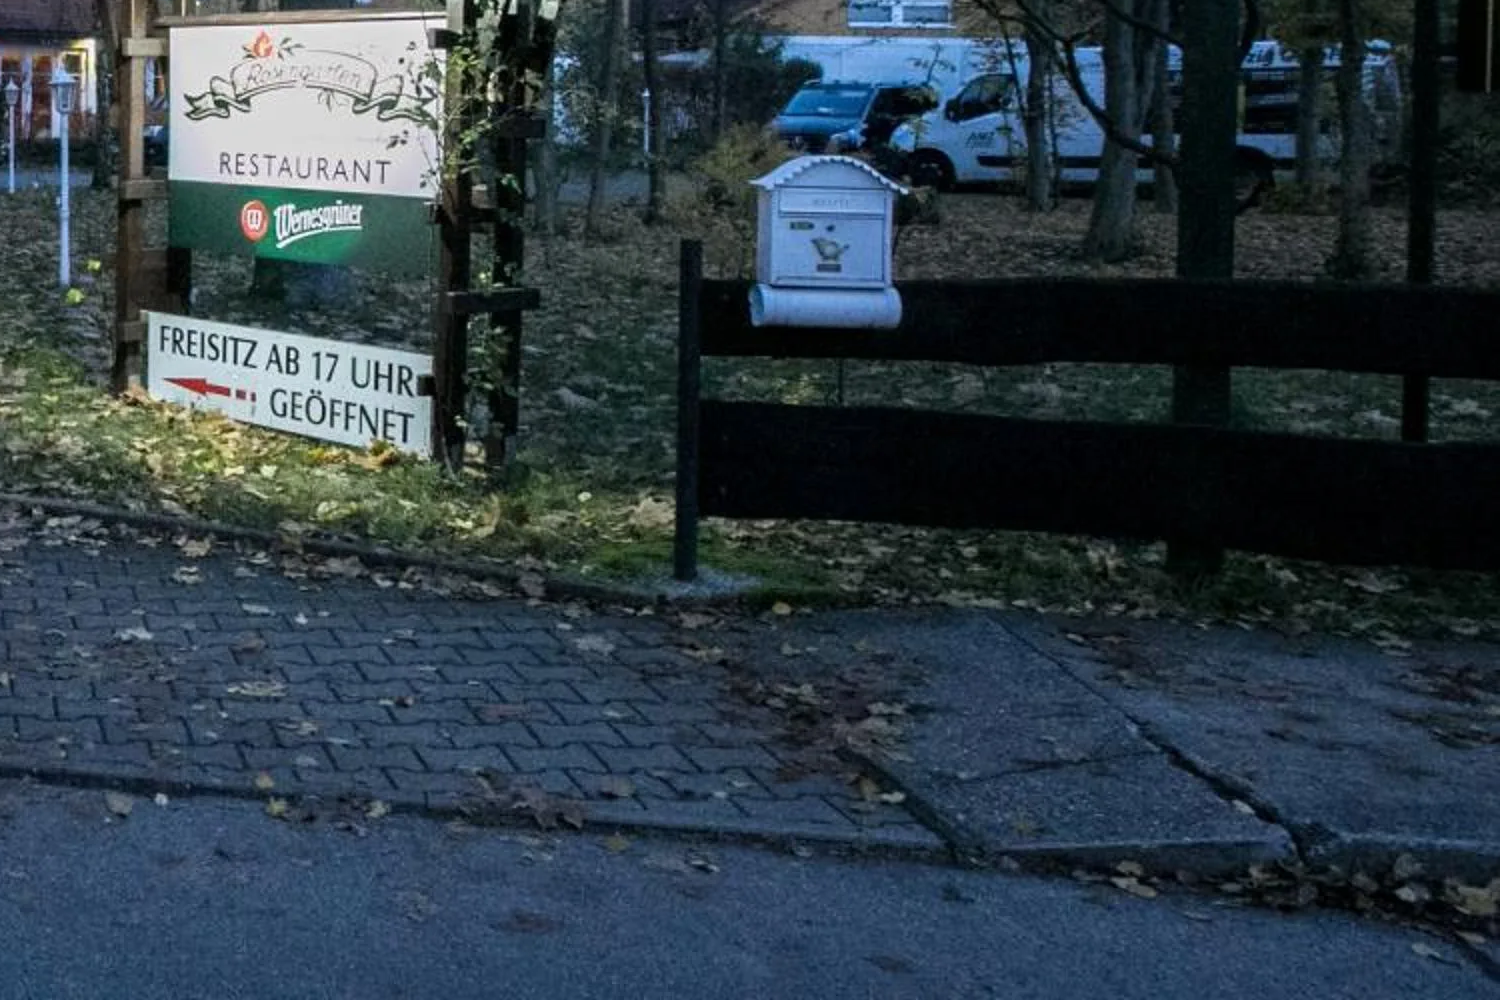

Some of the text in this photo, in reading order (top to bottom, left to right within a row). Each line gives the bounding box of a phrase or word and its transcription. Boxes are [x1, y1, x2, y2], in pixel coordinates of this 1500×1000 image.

[219, 151, 392, 185] RESTAURANT
[273, 200, 363, 242] Wernesgrüner
[160, 325, 416, 398] FREISITZ AB 17 UHR
[269, 388, 415, 444] GEÖFFNET
